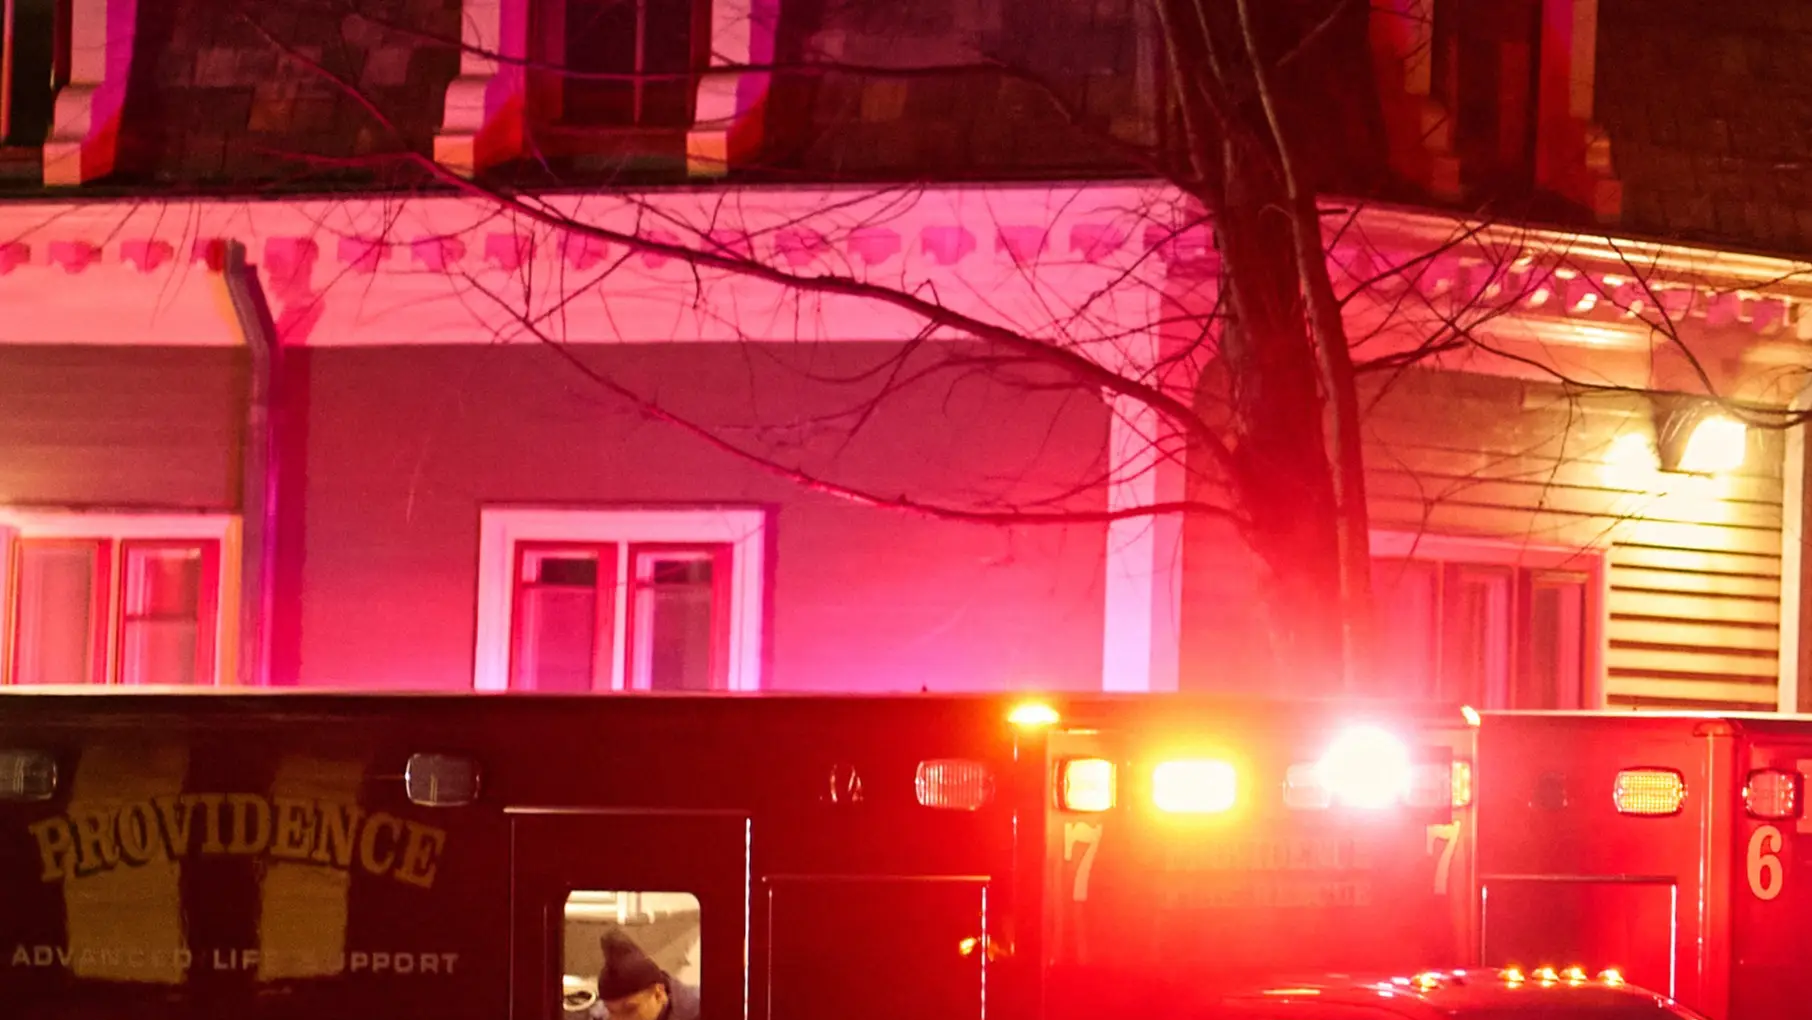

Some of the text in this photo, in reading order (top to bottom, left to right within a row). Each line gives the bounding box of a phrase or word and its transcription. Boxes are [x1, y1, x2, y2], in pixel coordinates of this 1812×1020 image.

[28, 791, 448, 890] PROVIDENCE
[1063, 821, 1103, 903] 7
[1425, 819, 1462, 896] 7
[1746, 825, 1783, 900] 6
[11, 944, 459, 976] ADVANCED LIFE SUPPORT
